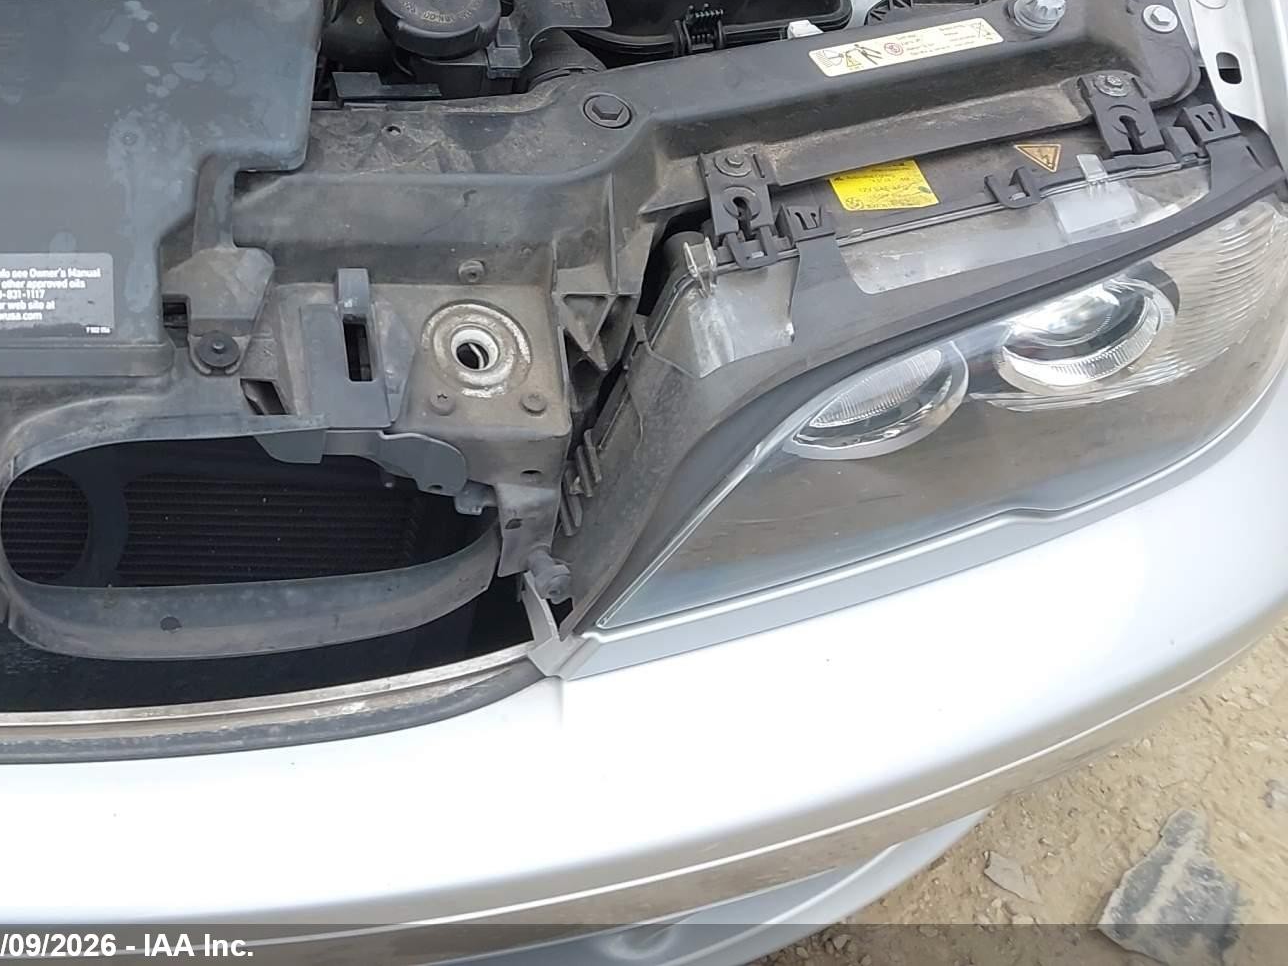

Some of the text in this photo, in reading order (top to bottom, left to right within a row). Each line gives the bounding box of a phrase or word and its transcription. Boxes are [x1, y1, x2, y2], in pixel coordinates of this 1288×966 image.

[12, 270, 28, 278] see
[29, 268, 66, 278] Owner's
[68, 267, 101, 278] Manual
[1, 279, 26, 289] other
[26, 279, 68, 291] approved
[69, 278, 86, 288] oils
[7, 300, 27, 310] web
[28, 300, 44, 310] site
[45, 301, 56, 310] at
